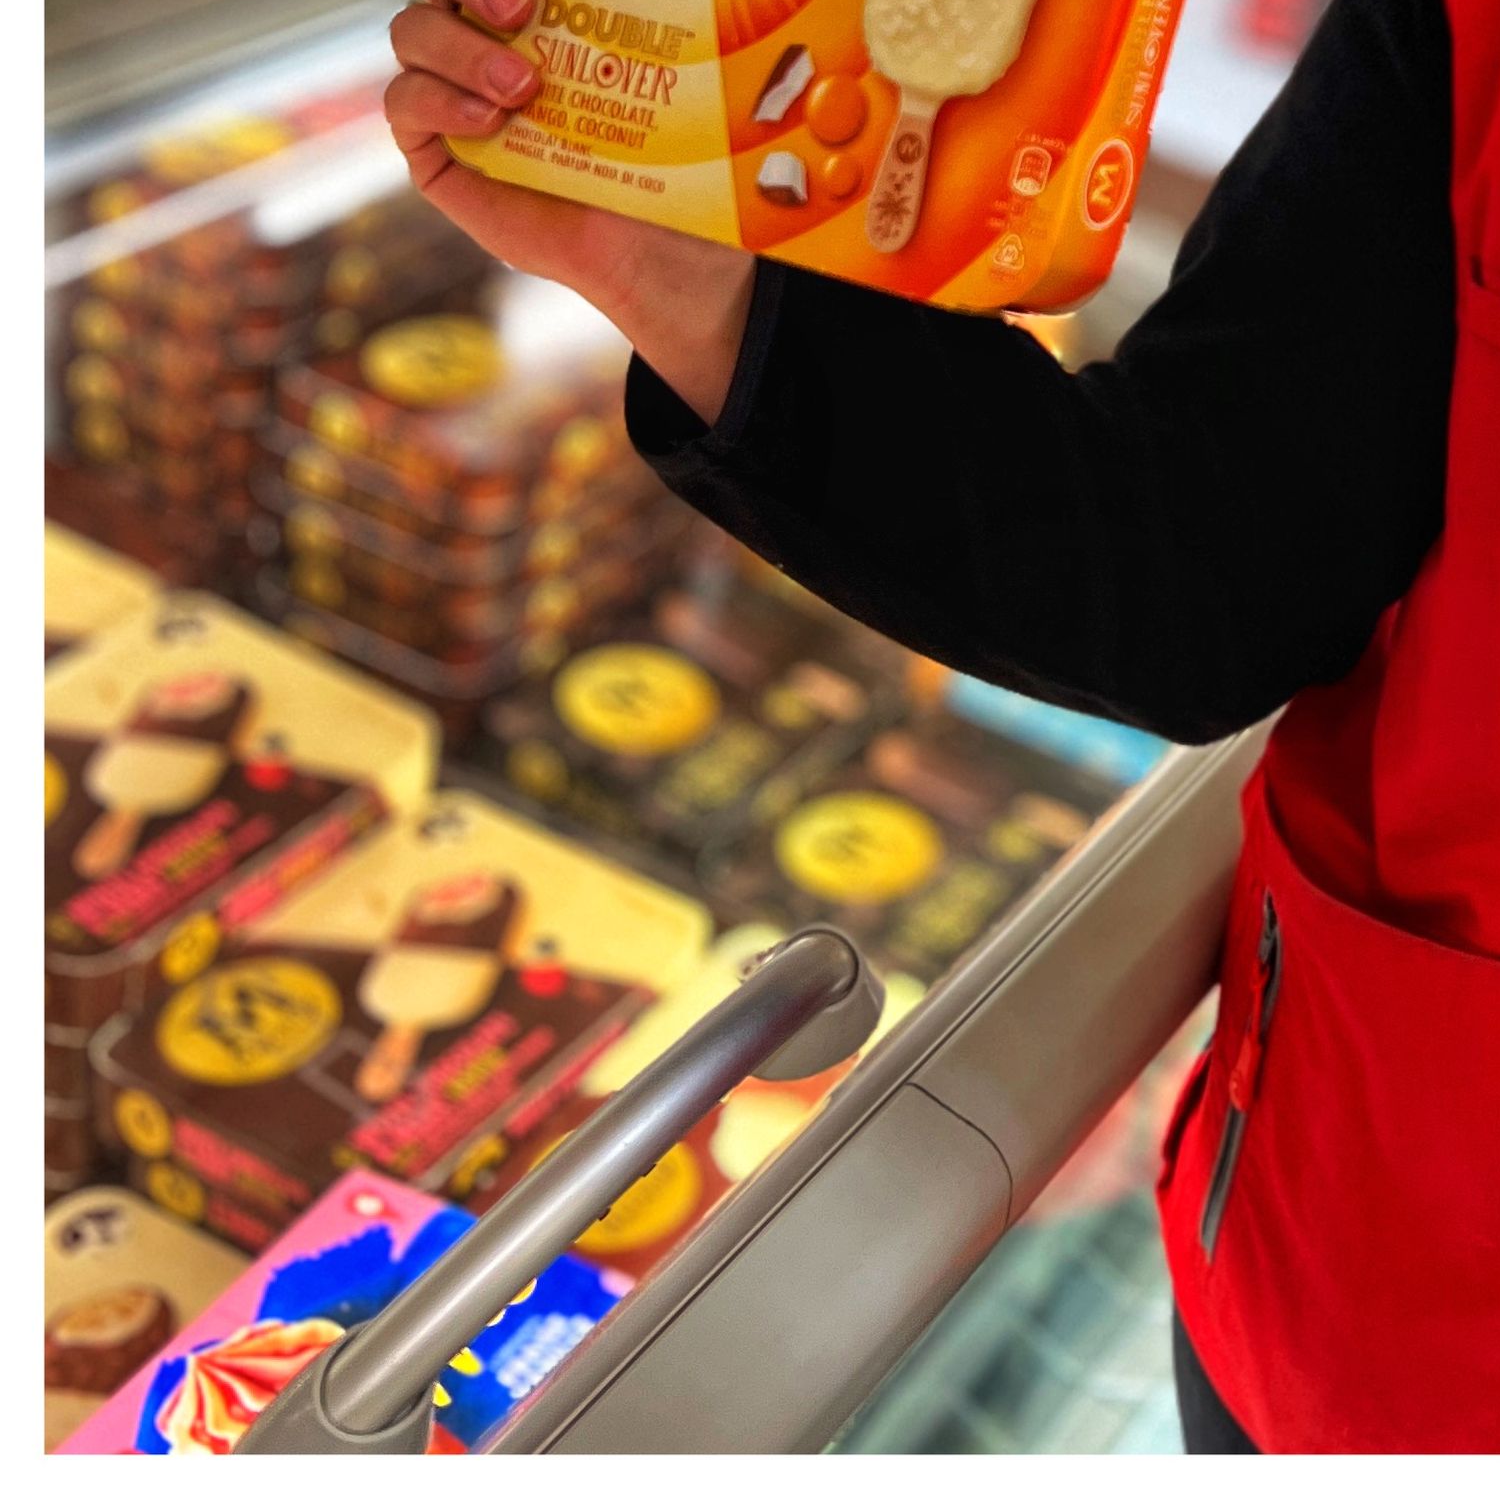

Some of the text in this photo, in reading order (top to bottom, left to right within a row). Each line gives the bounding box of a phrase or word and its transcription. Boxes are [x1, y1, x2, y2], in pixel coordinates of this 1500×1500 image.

[532, 35, 678, 106] SUNLOVER
[524, 104, 648, 149] ANGO, COCONUT
